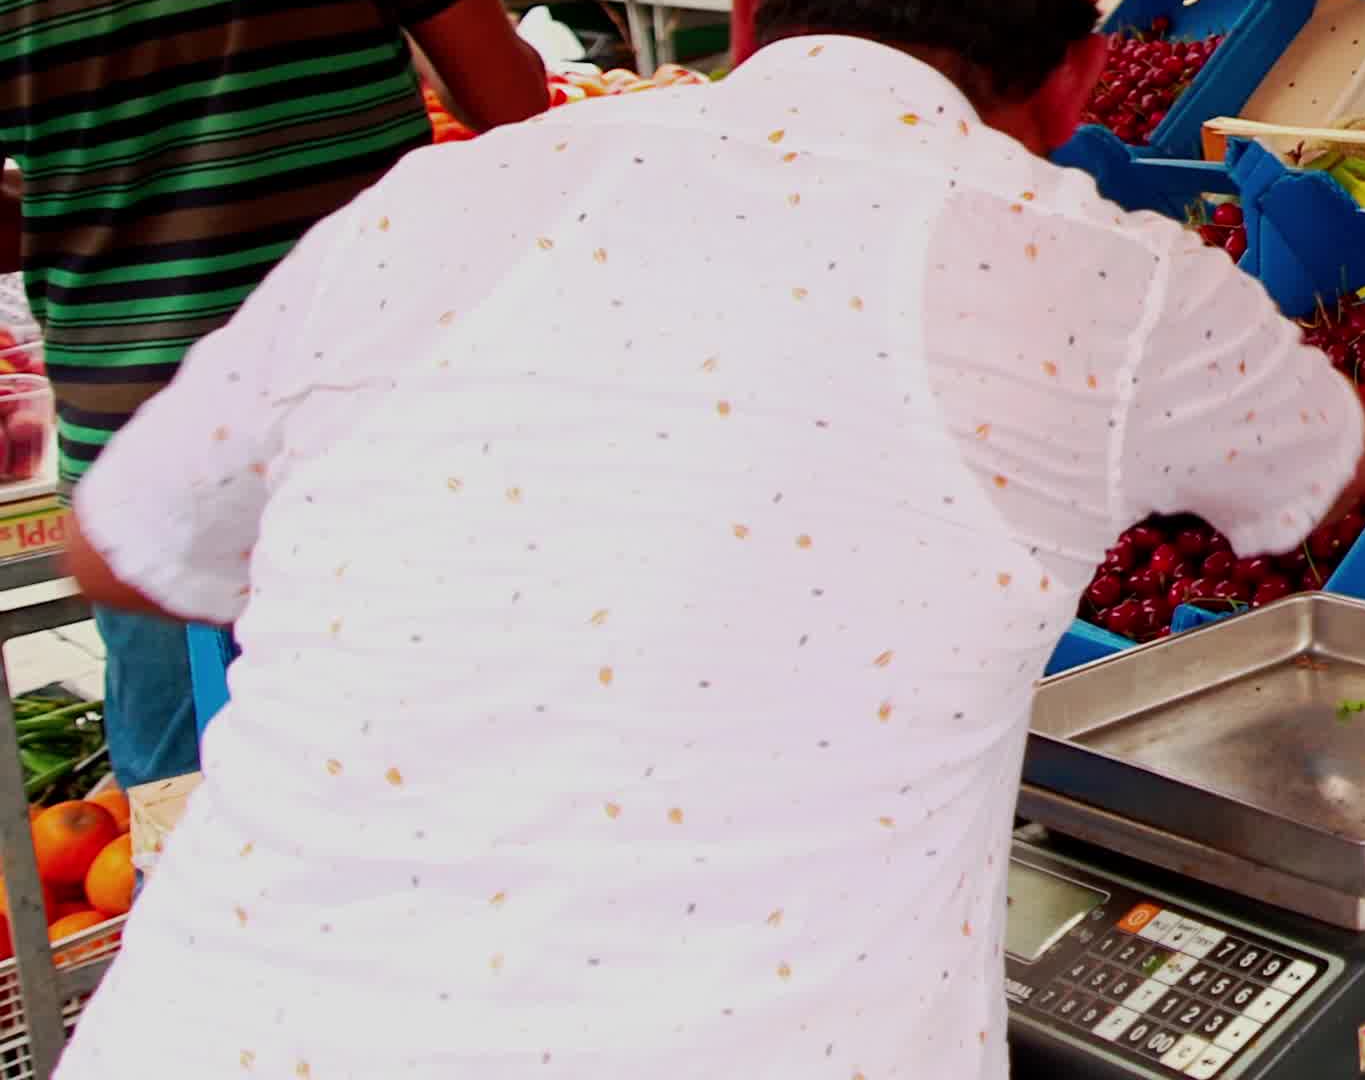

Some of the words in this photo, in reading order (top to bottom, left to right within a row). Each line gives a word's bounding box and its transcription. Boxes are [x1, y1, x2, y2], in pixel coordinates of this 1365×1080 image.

[1217, 942, 1237, 958] 7
[1239, 952, 1258, 967] 8
[1262, 961, 1280, 976] 9
[1188, 970, 1207, 986] 4
[1210, 979, 1230, 994] 5
[1234, 989, 1252, 1004] 6
[1161, 998, 1177, 1013] 1
[1180, 1007, 1201, 1023] 2
[1204, 1016, 1223, 1032] 3
[1128, 1026, 1147, 1041] 0
[1147, 1033, 1178, 1053] 00
